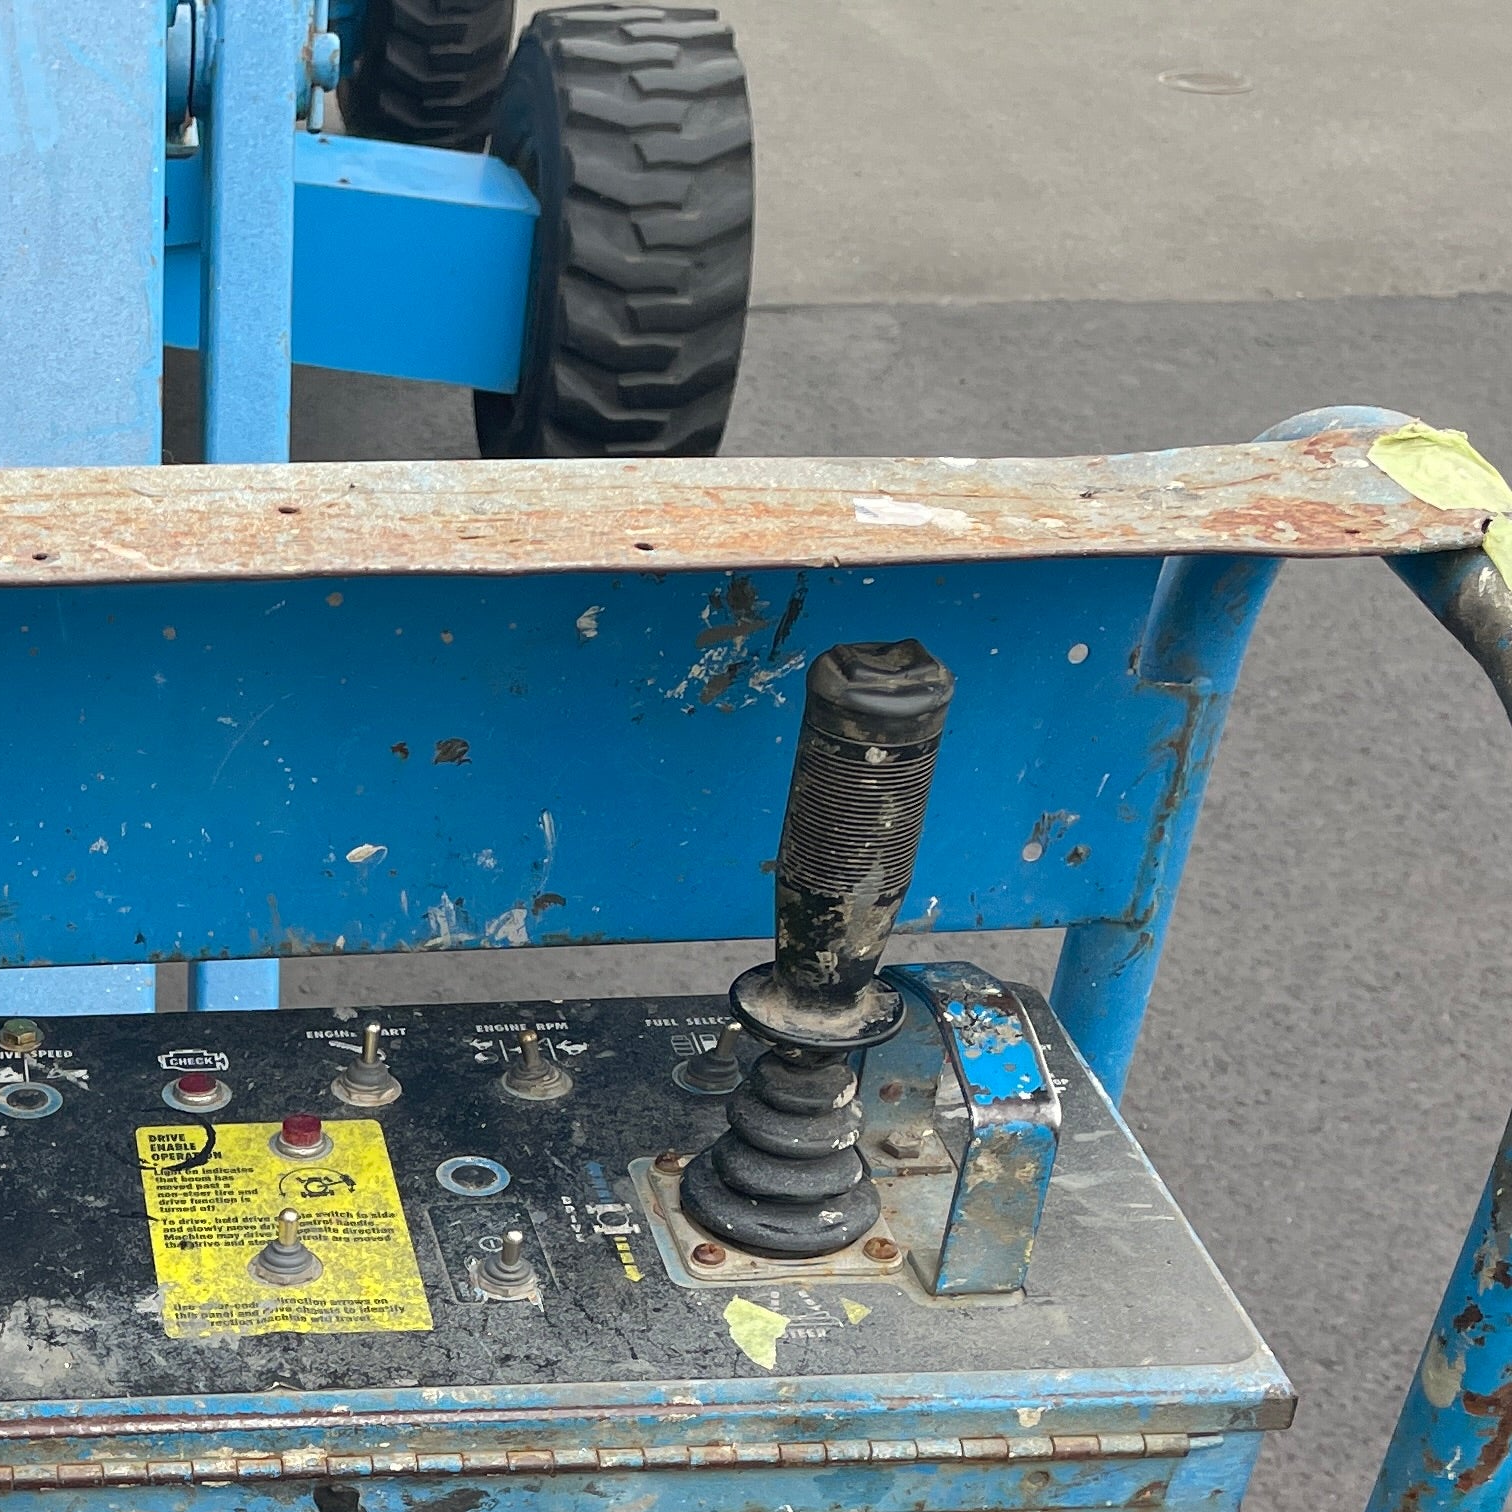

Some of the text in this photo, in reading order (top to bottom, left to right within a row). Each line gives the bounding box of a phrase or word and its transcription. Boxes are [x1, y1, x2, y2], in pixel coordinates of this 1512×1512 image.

[475, 1021, 569, 1034] ENGINE RPM
[645, 1018, 679, 1028] FUEL
[30, 1050, 74, 1059] SPEED
[169, 1056, 214, 1067] CHECK
[148, 1133, 186, 1143] DRIVE
[150, 1142, 197, 1152] ENABLE
